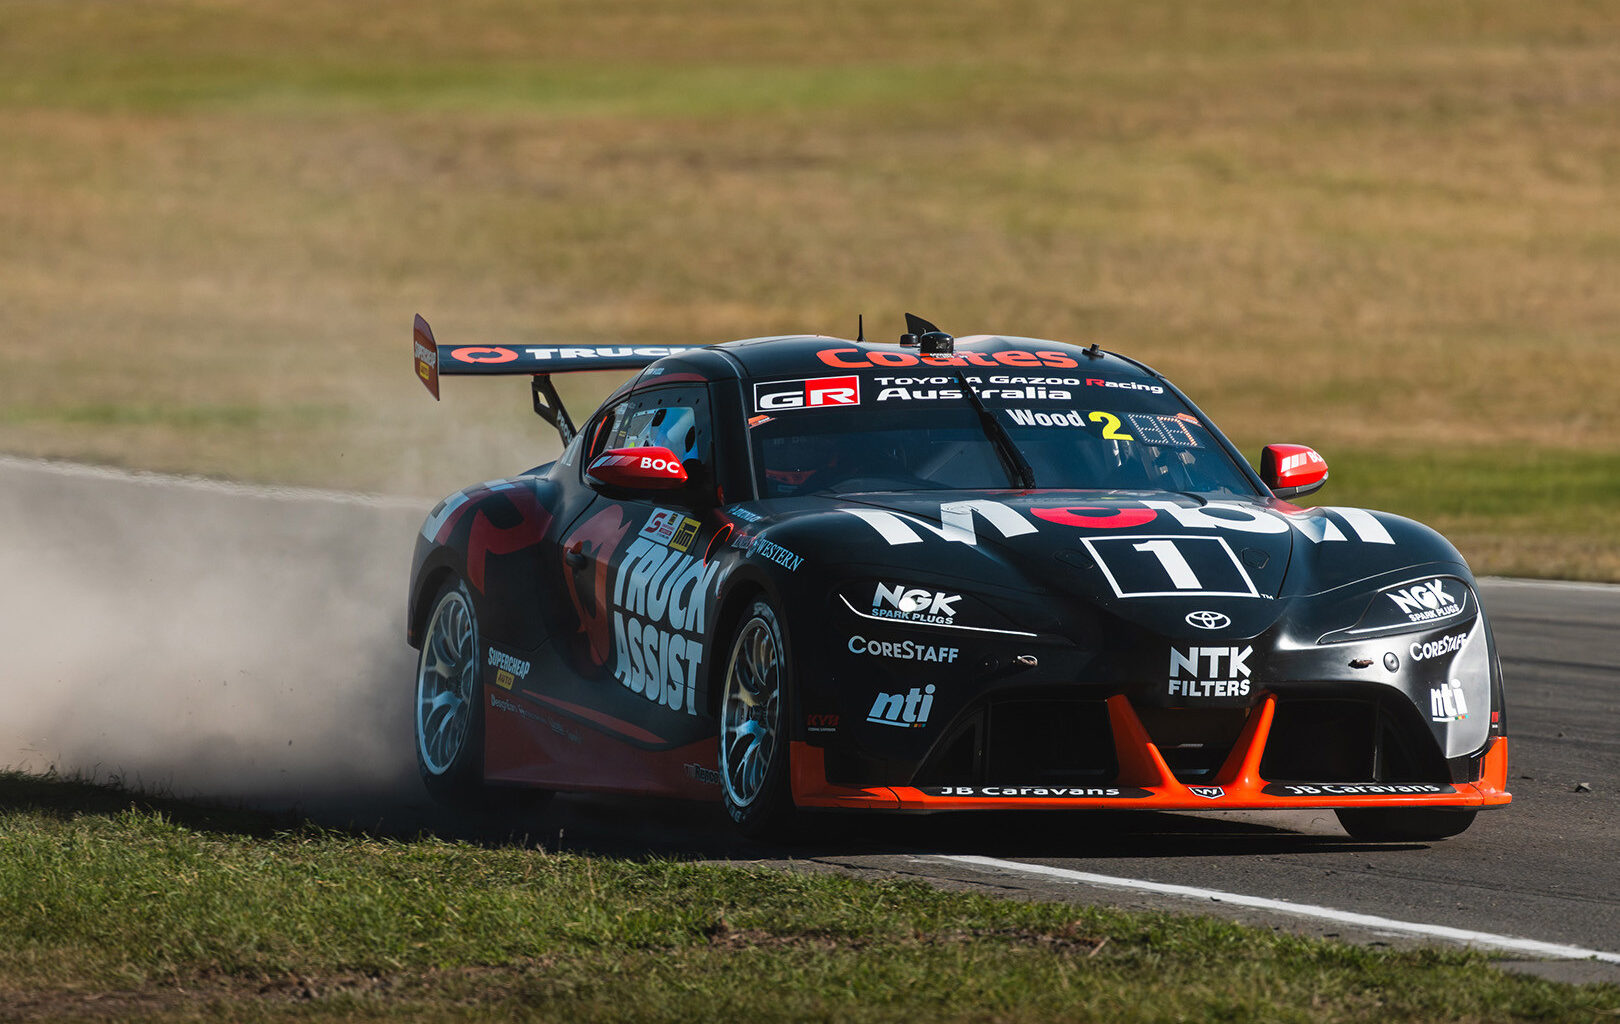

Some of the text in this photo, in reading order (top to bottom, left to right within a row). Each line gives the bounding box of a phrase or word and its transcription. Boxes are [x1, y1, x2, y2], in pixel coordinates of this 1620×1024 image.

[816, 348, 1078, 368] Coates
[760, 387, 855, 409] GR
[874, 375, 1164, 394] TOYOTA GAZOO Racing
[1005, 409, 1134, 441] Wood 2
[640, 457, 680, 473] BOC
[835, 500, 1396, 546] Mobil
[756, 539, 805, 572] WESTERN
[1132, 540, 1203, 589] 1
[614, 537, 720, 634] TRUCK
[872, 581, 962, 617] NGK
[1386, 578, 1455, 614] NGK
[872, 608, 954, 625] SPARK PLUGS
[1408, 603, 1460, 622] SPARK PLUGS
[487, 646, 531, 680] SUPERCHEAP
[614, 611, 703, 716] ASSIST
[1168, 645, 1254, 678] NTK
[868, 684, 936, 723] nti
[1168, 679, 1251, 697] FILTERS
[1430, 678, 1468, 717] nti
[941, 786, 1120, 796] JB Caravans
[1285, 783, 1441, 795] JB Caravans
